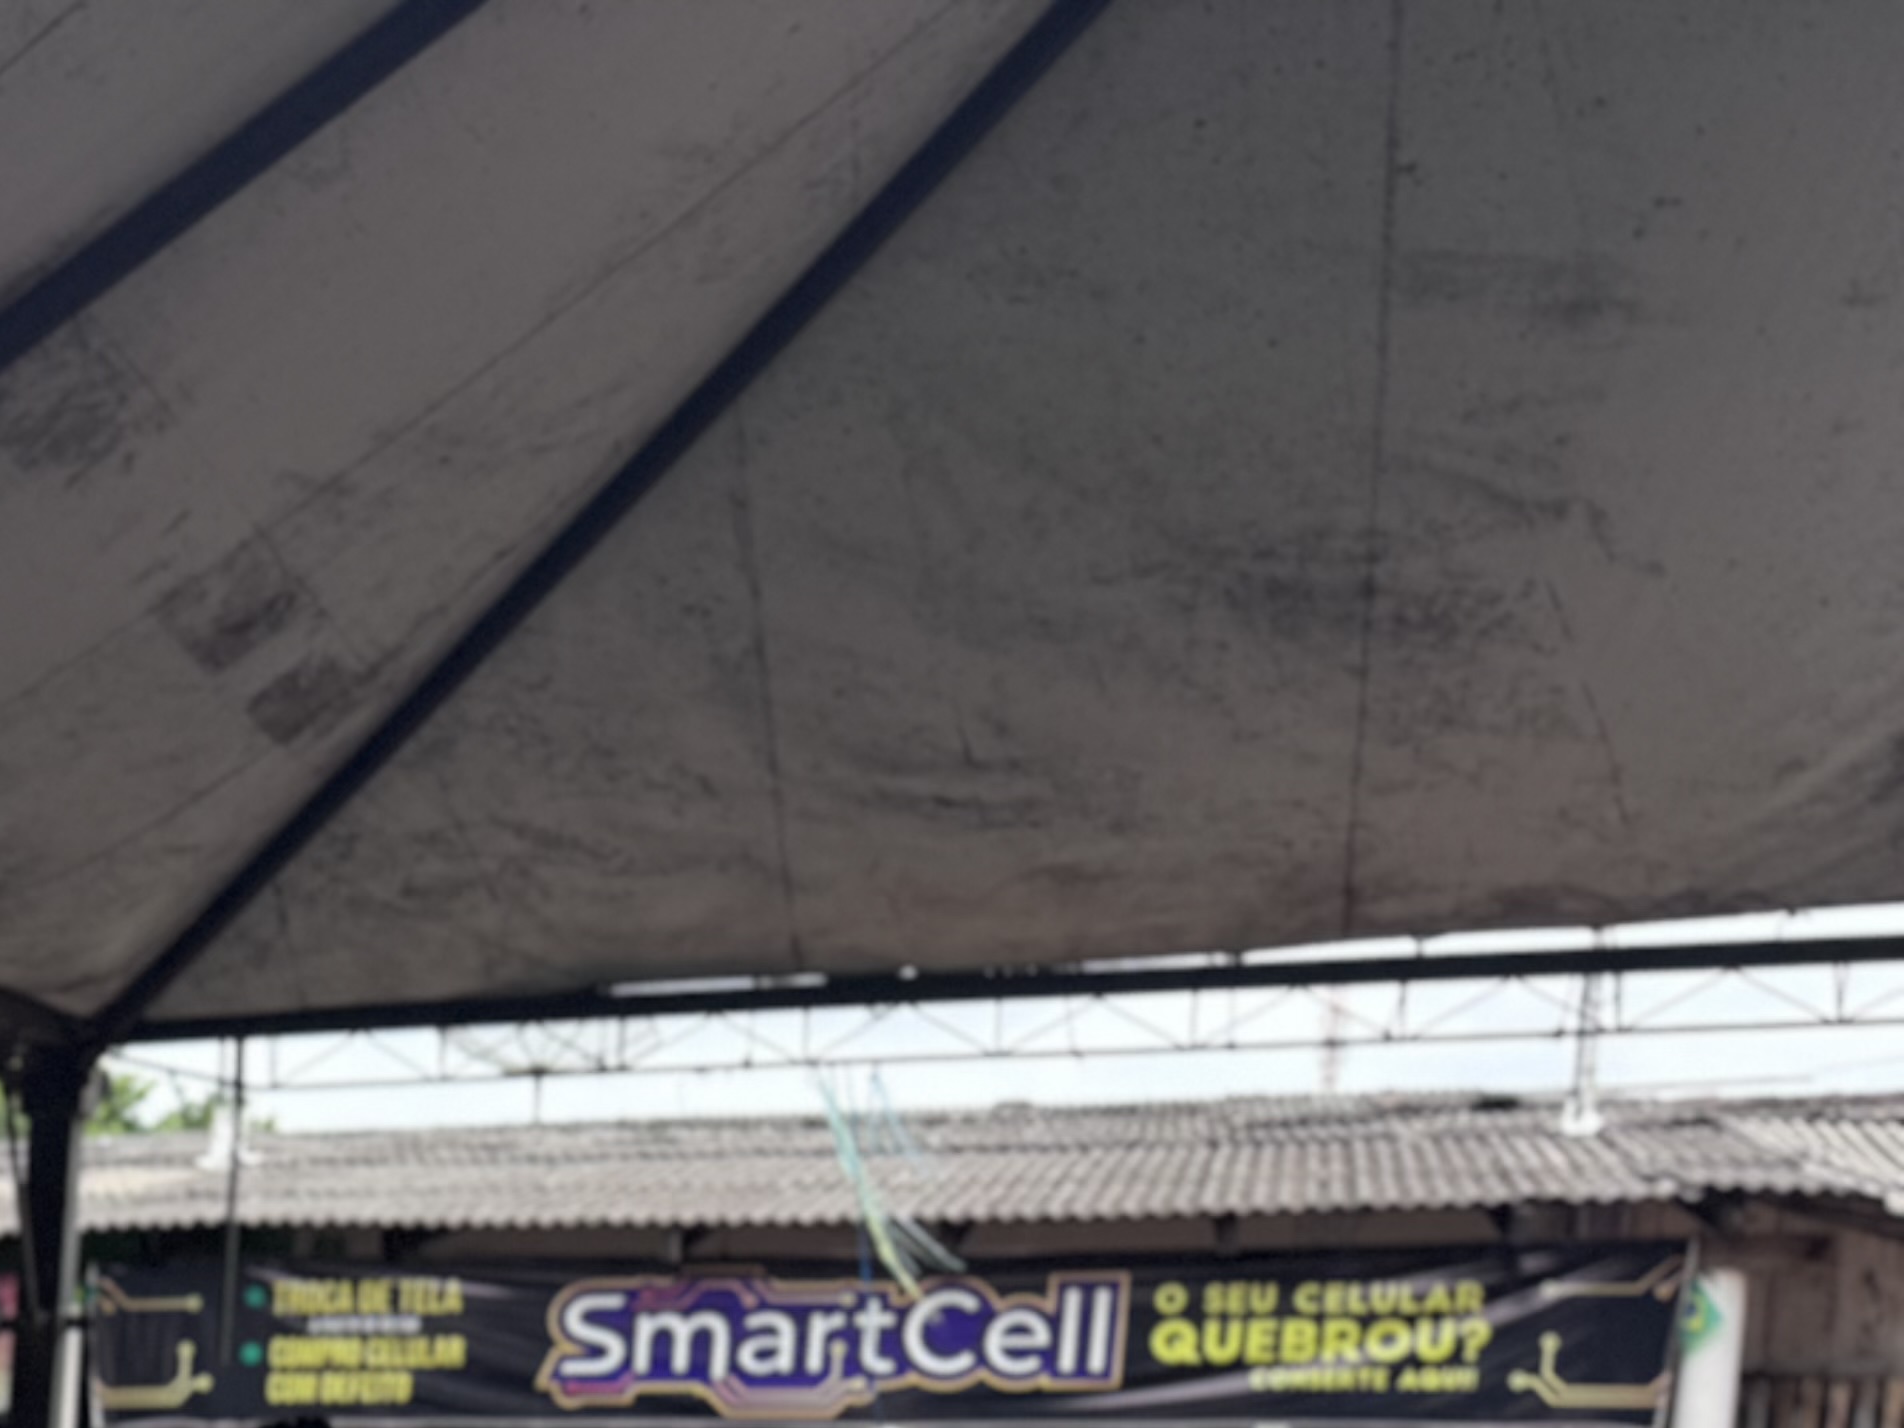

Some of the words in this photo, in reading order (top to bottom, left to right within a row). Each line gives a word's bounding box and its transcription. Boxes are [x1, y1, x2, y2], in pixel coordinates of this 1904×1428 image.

[1153, 1281, 1189, 1317] O
[1202, 1280, 1280, 1317] SEU
[1293, 1280, 1486, 1317] CELULAR
[558, 1285, 1113, 1383] SmartCell
[1149, 1317, 1494, 1367] QUEBROU?
